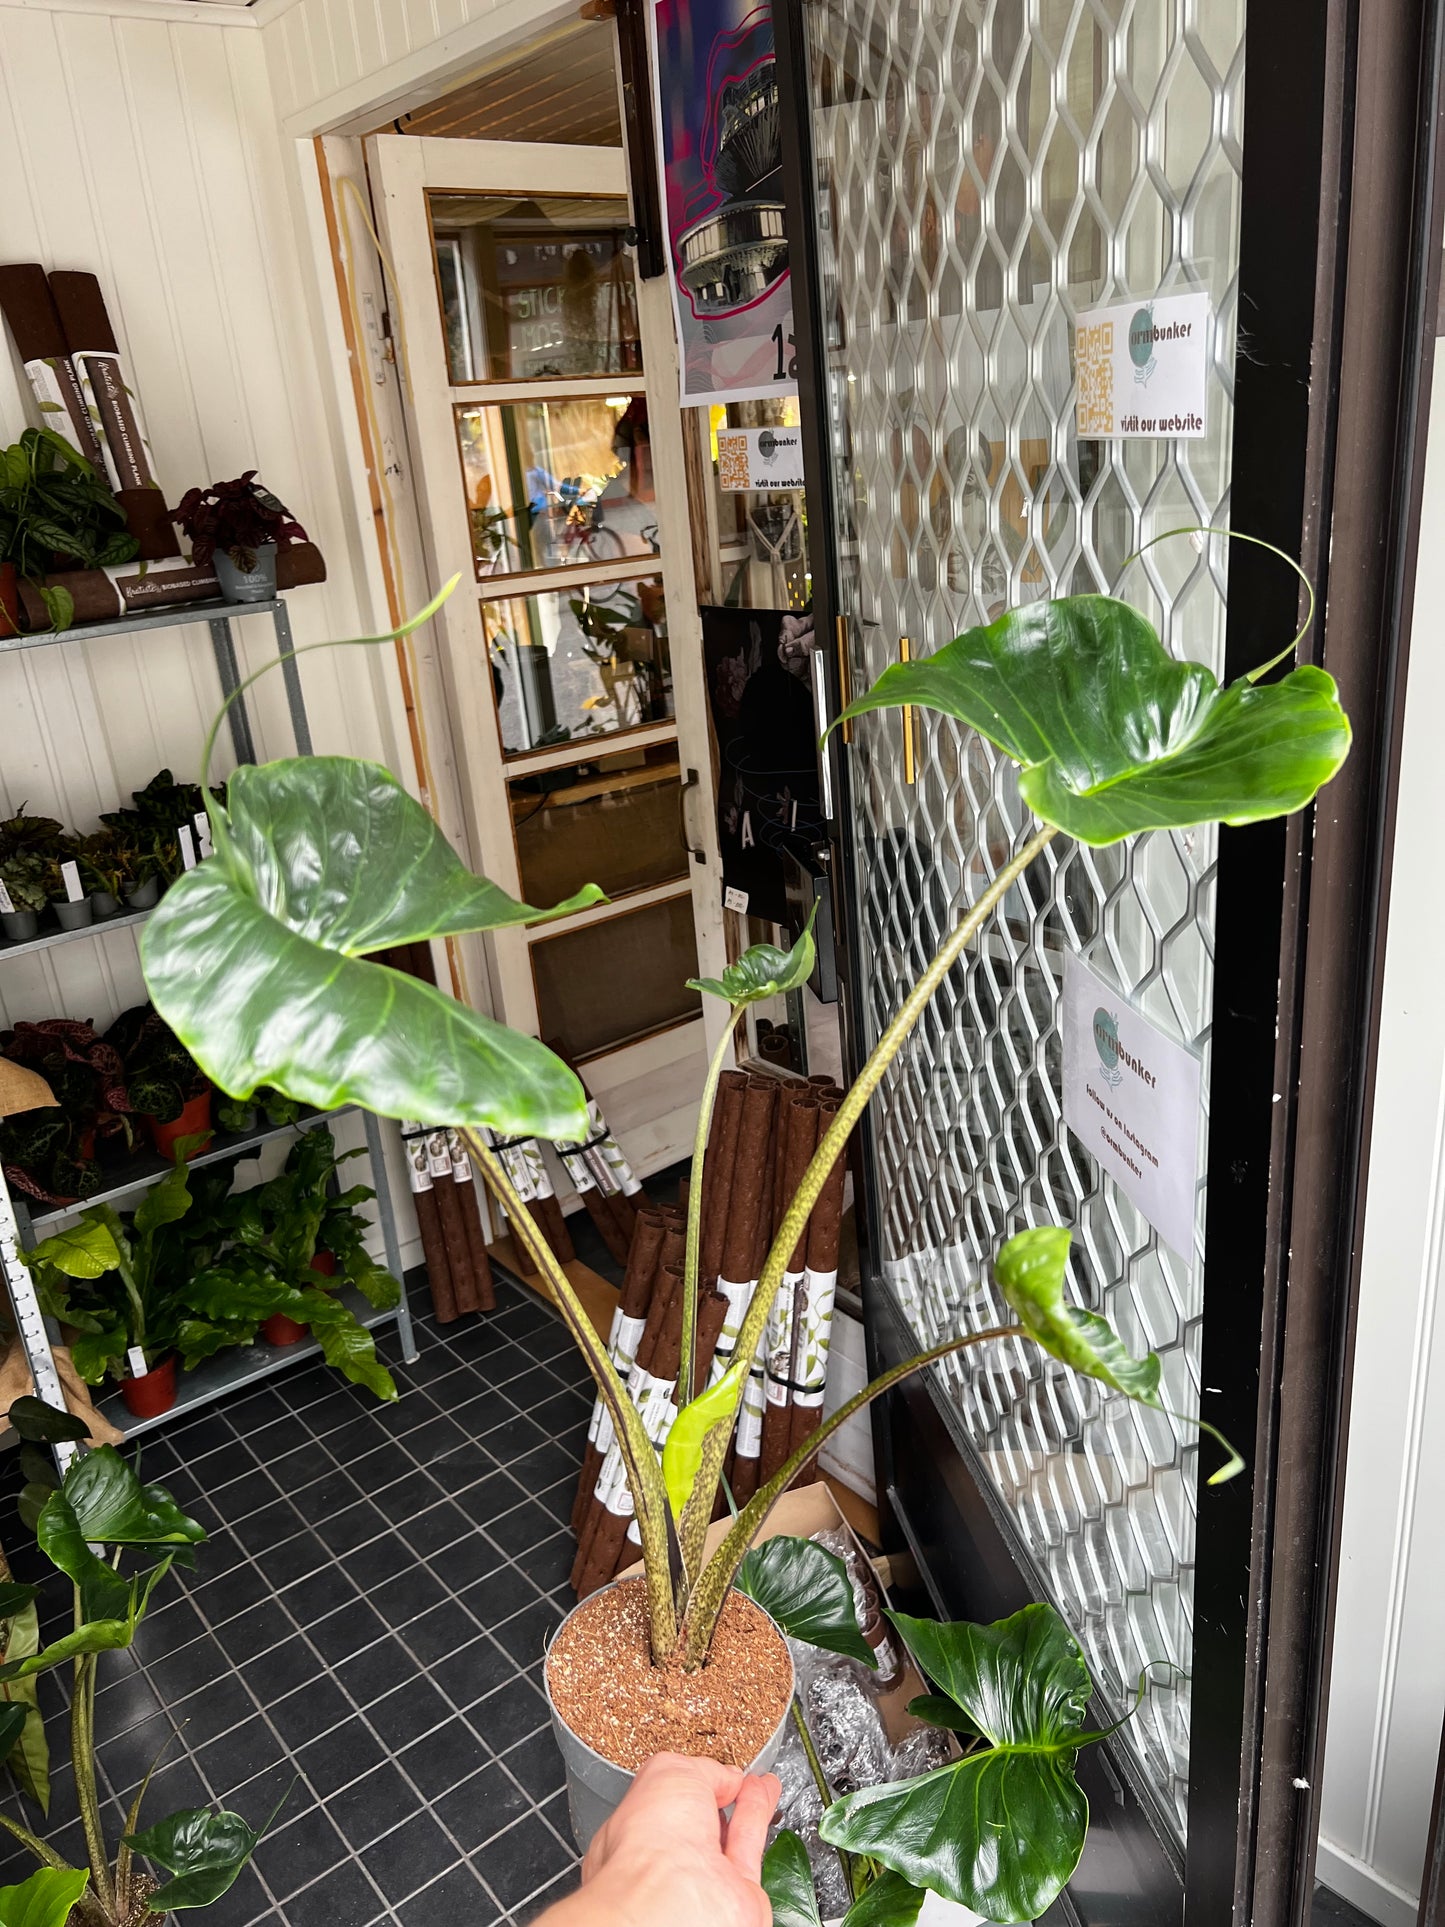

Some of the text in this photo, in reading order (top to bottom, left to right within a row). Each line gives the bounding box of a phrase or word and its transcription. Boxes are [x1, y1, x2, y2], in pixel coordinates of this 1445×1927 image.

[1130, 321, 1192, 346] ormbunker
[63, 359, 76, 382] PLANK
[72, 382, 88, 417] CLIMBING
[1141, 418, 1157, 432] our
[1159, 413, 1203, 431] website
[111, 400, 126, 431] BIOBASED
[121, 432, 136, 464] CLIMBING
[131, 464, 143, 486] PLANK
[759, 436, 798, 448] ormbunker
[770, 480, 780, 488] our
[1095, 1023, 1157, 1090] ormbunker
[1086, 1083, 1105, 1112] follow
[1106, 1108, 1113, 1119] us
[1114, 1117, 1123, 1131] on
[1100, 1126, 1142, 1179] @ormbunker
